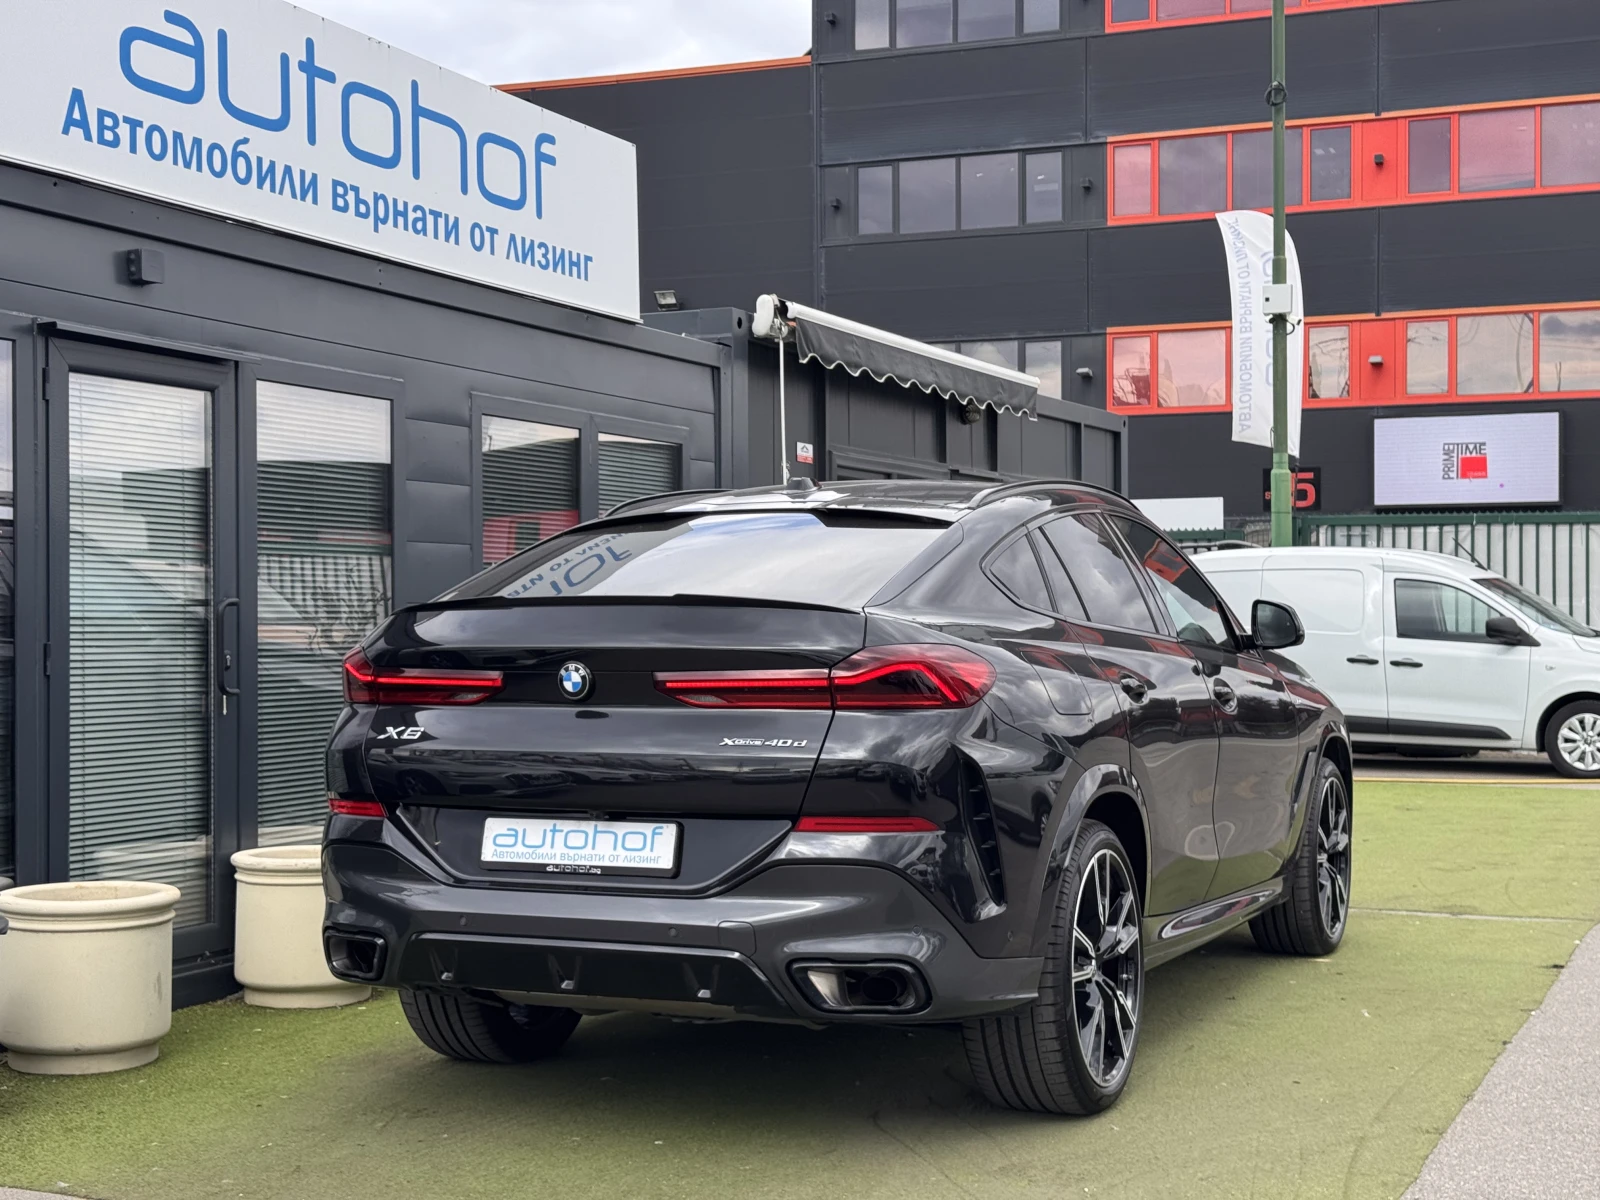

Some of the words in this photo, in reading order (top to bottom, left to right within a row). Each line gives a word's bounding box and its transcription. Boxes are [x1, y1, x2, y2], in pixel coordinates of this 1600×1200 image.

[119, 9, 557, 220] autohof
[61, 87, 318, 206] Автомобили
[332, 179, 460, 246] върнати
[470, 225, 501, 256] от
[505, 232, 593, 282] лизинг
[376, 726, 425, 739] X6
[493, 823, 664, 852] autohof
[491, 849, 557, 860] Автомобили
[559, 852, 605, 863] върнати
[608, 854, 620, 863] от
[622, 854, 662, 864] лизинг
[546, 864, 602, 874] autohof.bg
